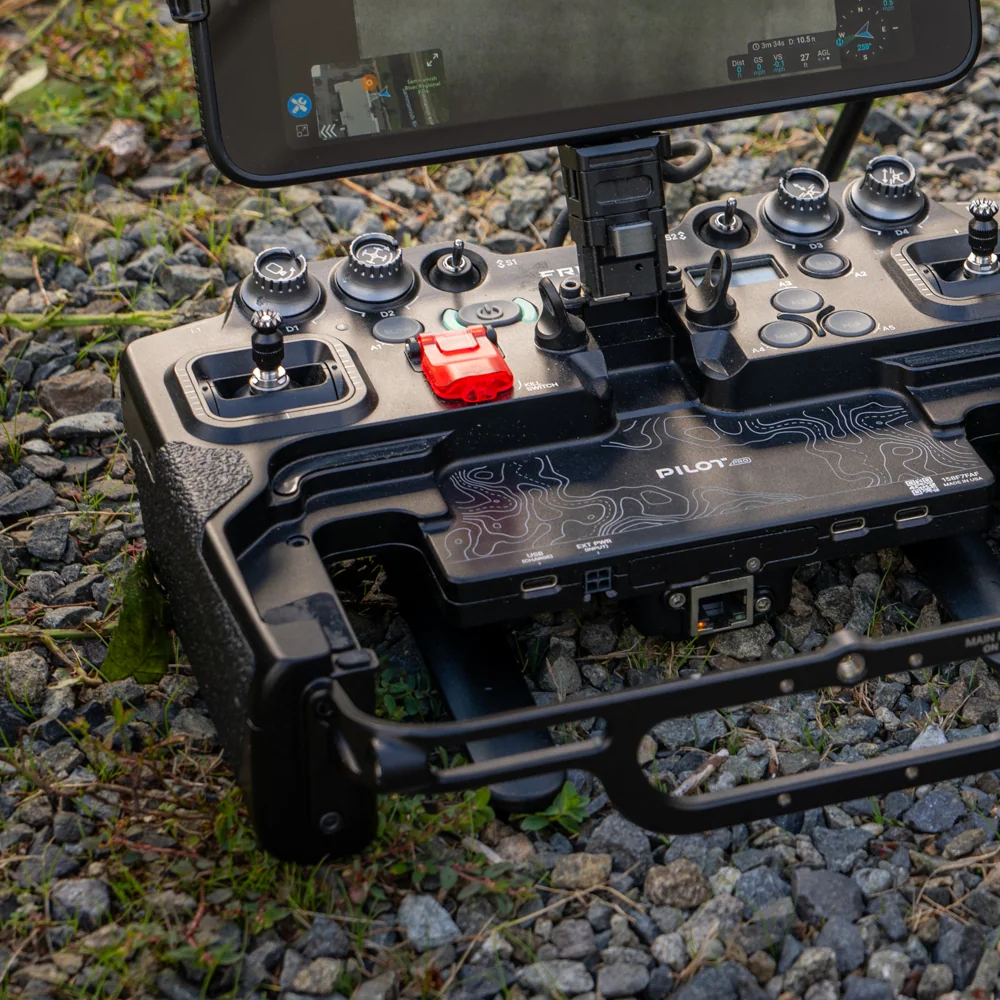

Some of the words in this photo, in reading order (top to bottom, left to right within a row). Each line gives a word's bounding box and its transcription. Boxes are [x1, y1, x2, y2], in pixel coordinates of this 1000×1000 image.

[772, 40, 785, 48] 34s
[796, 36, 810, 44] 10.5
[800, 54, 809, 62] 27
[894, 228, 910, 236] D4
[664, 233, 678, 241] S2
[506, 259, 518, 267] S1
[380, 310, 395, 318] D2
[286, 324, 300, 333] D1
[883, 324, 896, 332] A5
[370, 343, 382, 351] A1
[526, 382, 558, 392] SWITCH
[656, 458, 727, 478] PILOT
[576, 542, 592, 550] EXT
[964, 632, 995, 648] MAIN
[982, 642, 999, 653] ON
